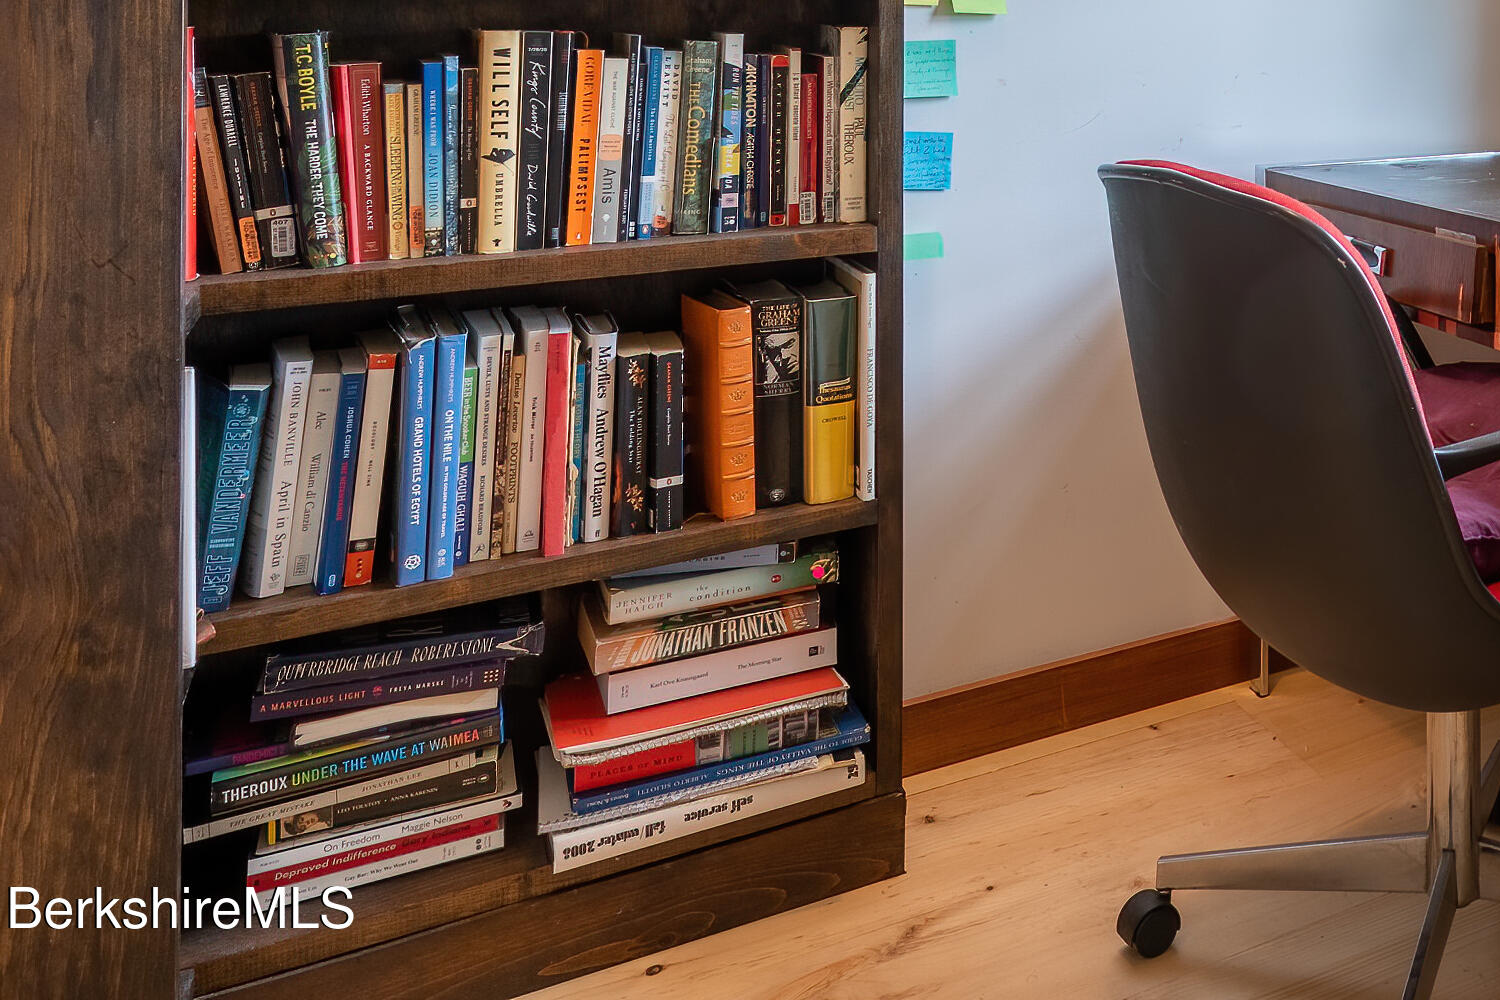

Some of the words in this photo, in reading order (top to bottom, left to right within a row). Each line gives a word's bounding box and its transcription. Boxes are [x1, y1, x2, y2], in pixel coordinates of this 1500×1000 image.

[491, 47, 512, 93] WILL
[526, 60, 547, 95] Kings
[685, 56, 712, 66] Graham
[685, 65, 710, 74] Greene
[360, 78, 371, 99] Edith
[662, 56, 672, 108] LEAVITT
[671, 63, 680, 101] DAVID
[689, 81, 702, 105] THE
[744, 61, 758, 129] AKHNATON
[217, 83, 236, 118] LAWRENCE
[361, 99, 373, 136] Wharton
[223, 119, 238, 148] DURRELL
[304, 118, 318, 139] THE
[490, 98, 510, 140] SELF
[525, 96, 547, 140] County
[307, 140, 322, 180] HARDER
[389, 135, 403, 186] SLEEPING
[682, 105, 707, 196] Comedians
[844, 122, 855, 165] THEROUX
[428, 153, 439, 178] JOAN
[575, 138, 592, 212] PALIMPSEST
[311, 182, 325, 208] THEY
[428, 181, 439, 218] DIDION
[493, 173, 505, 227] UMBRELLA
[601, 167, 617, 204] Amis
[313, 210, 328, 240] COME
[758, 308, 800, 320] GRAHAM
[595, 345, 612, 399] Mayflies
[291, 382, 303, 408] JOHN
[315, 411, 327, 430] Alec
[345, 406, 355, 433] JOSHUA
[413, 416, 425, 447] GRAND
[443, 424, 455, 440] THE
[445, 408, 456, 424] ON
[594, 408, 609, 457] Andrew
[284, 412, 299, 467] BANVILLE
[343, 434, 352, 460] COHEN
[442, 442, 454, 462] NILE
[211, 418, 255, 535] VANDERMEER
[308, 453, 322, 488] William
[411, 448, 423, 482] HOTELS
[506, 440, 519, 504] FOOTPRINTS
[278, 480, 293, 514] April
[306, 490, 317, 501] di
[411, 483, 421, 496] OF
[590, 460, 607, 518] O'Hagan
[276, 516, 289, 529] in
[302, 500, 315, 532] Canzio
[409, 497, 421, 526] EGYPT
[270, 533, 287, 568] Spain
[202, 553, 233, 597] JEFF
[615, 591, 673, 609] JENNIFER
[624, 600, 665, 615] HAIGH
[689, 585, 752, 602] condition
[631, 623, 714, 664] JONATHAN
[719, 610, 788, 646] FRANZEN
[276, 653, 360, 685] OUTERBRIDGE
[363, 649, 403, 670] REACH
[410, 640, 451, 663] ROBERT
[451, 635, 496, 657] STONE
[737, 662, 748, 670] The
[747, 657, 769, 669] Morning
[770, 656, 783, 664] Star
[222, 776, 288, 804] THEROUX
[291, 763, 338, 787] UNDER
[342, 758, 367, 774] THE
[371, 746, 407, 768] WAVE
[411, 741, 425, 756] AT
[429, 728, 480, 751] WAIMEA
[361, 776, 407, 793] JONATHAN
[407, 771, 423, 780] LEE
[678, 774, 709, 787] ALBERTO
[683, 802, 730, 822] service
[728, 793, 755, 814] self
[323, 841, 339, 853] On
[340, 833, 381, 849] Freedom
[400, 819, 432, 835] Maggie
[433, 811, 464, 826] Nelson
